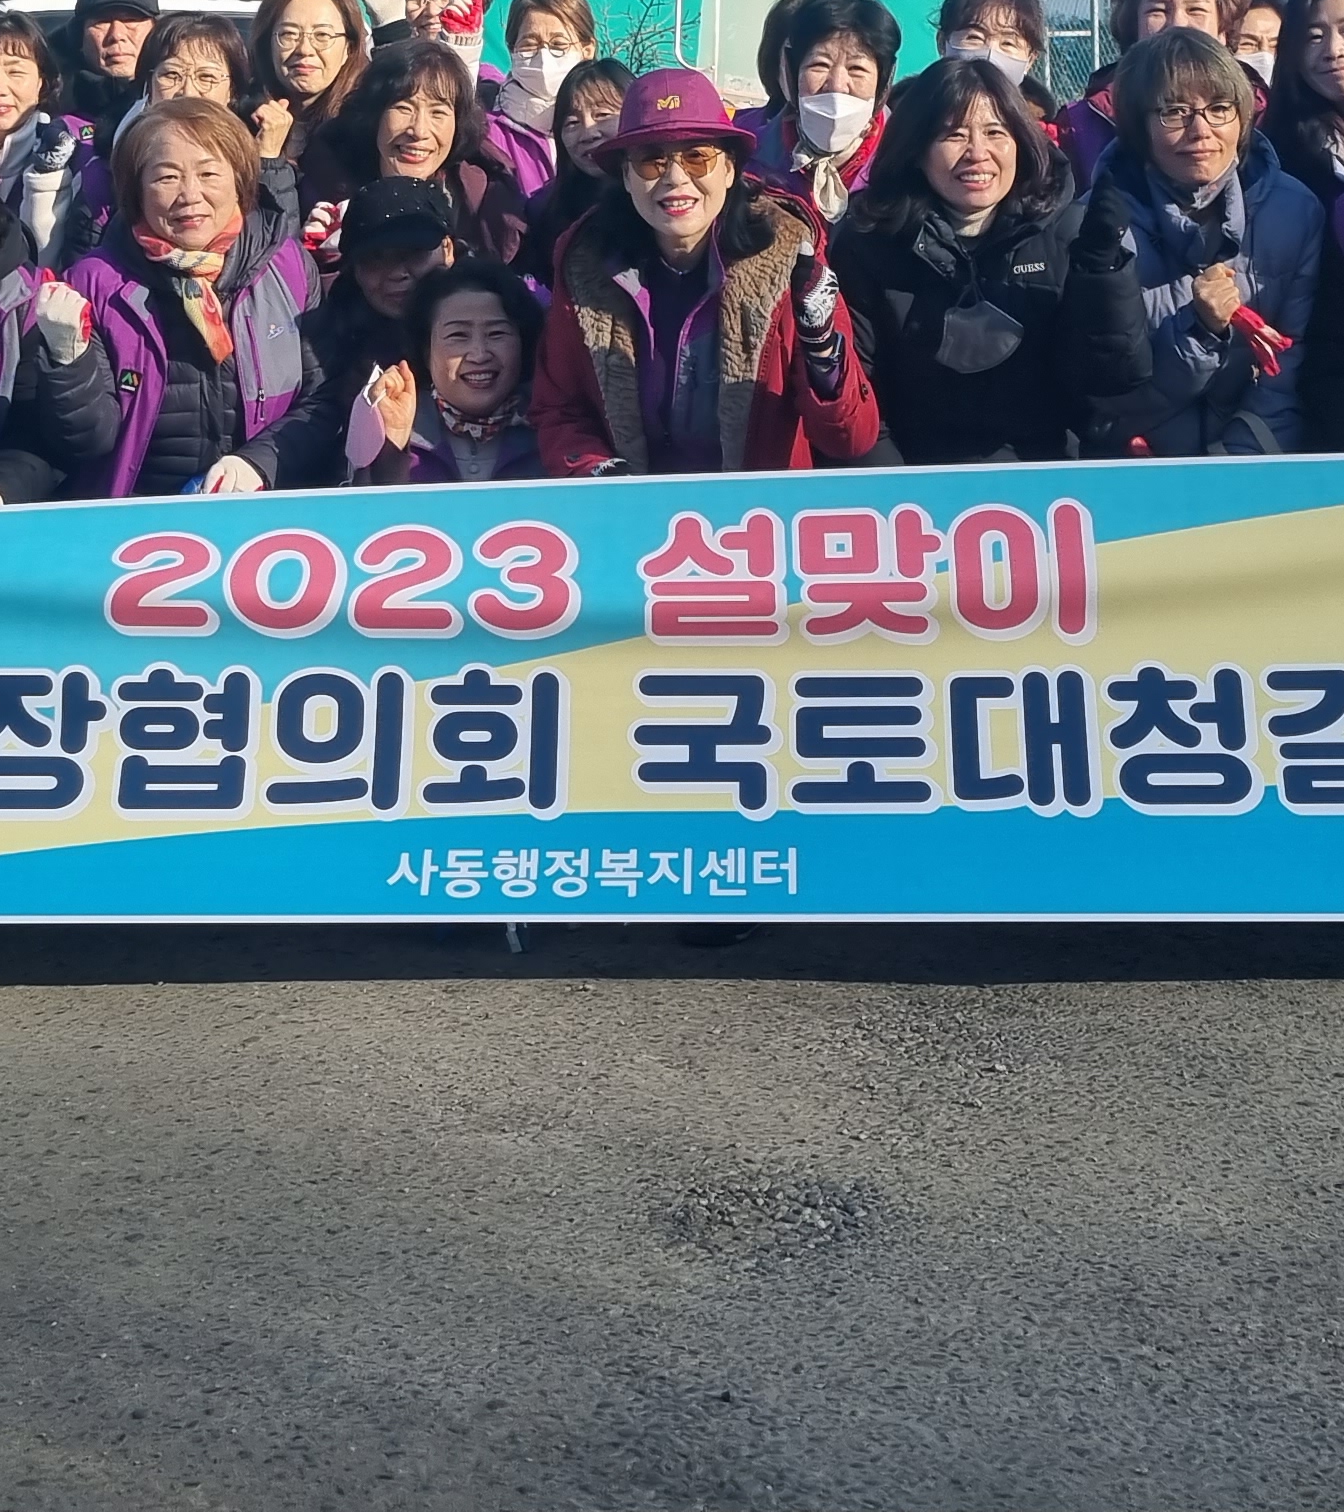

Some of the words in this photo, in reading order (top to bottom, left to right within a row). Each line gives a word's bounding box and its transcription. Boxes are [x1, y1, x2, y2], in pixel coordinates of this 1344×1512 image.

[1013, 262, 1046, 275] GUESS
[105, 520, 580, 639] 2023
[639, 498, 1098, 645] 설맞이
[386, 847, 800, 898] 사동행정복지센터
